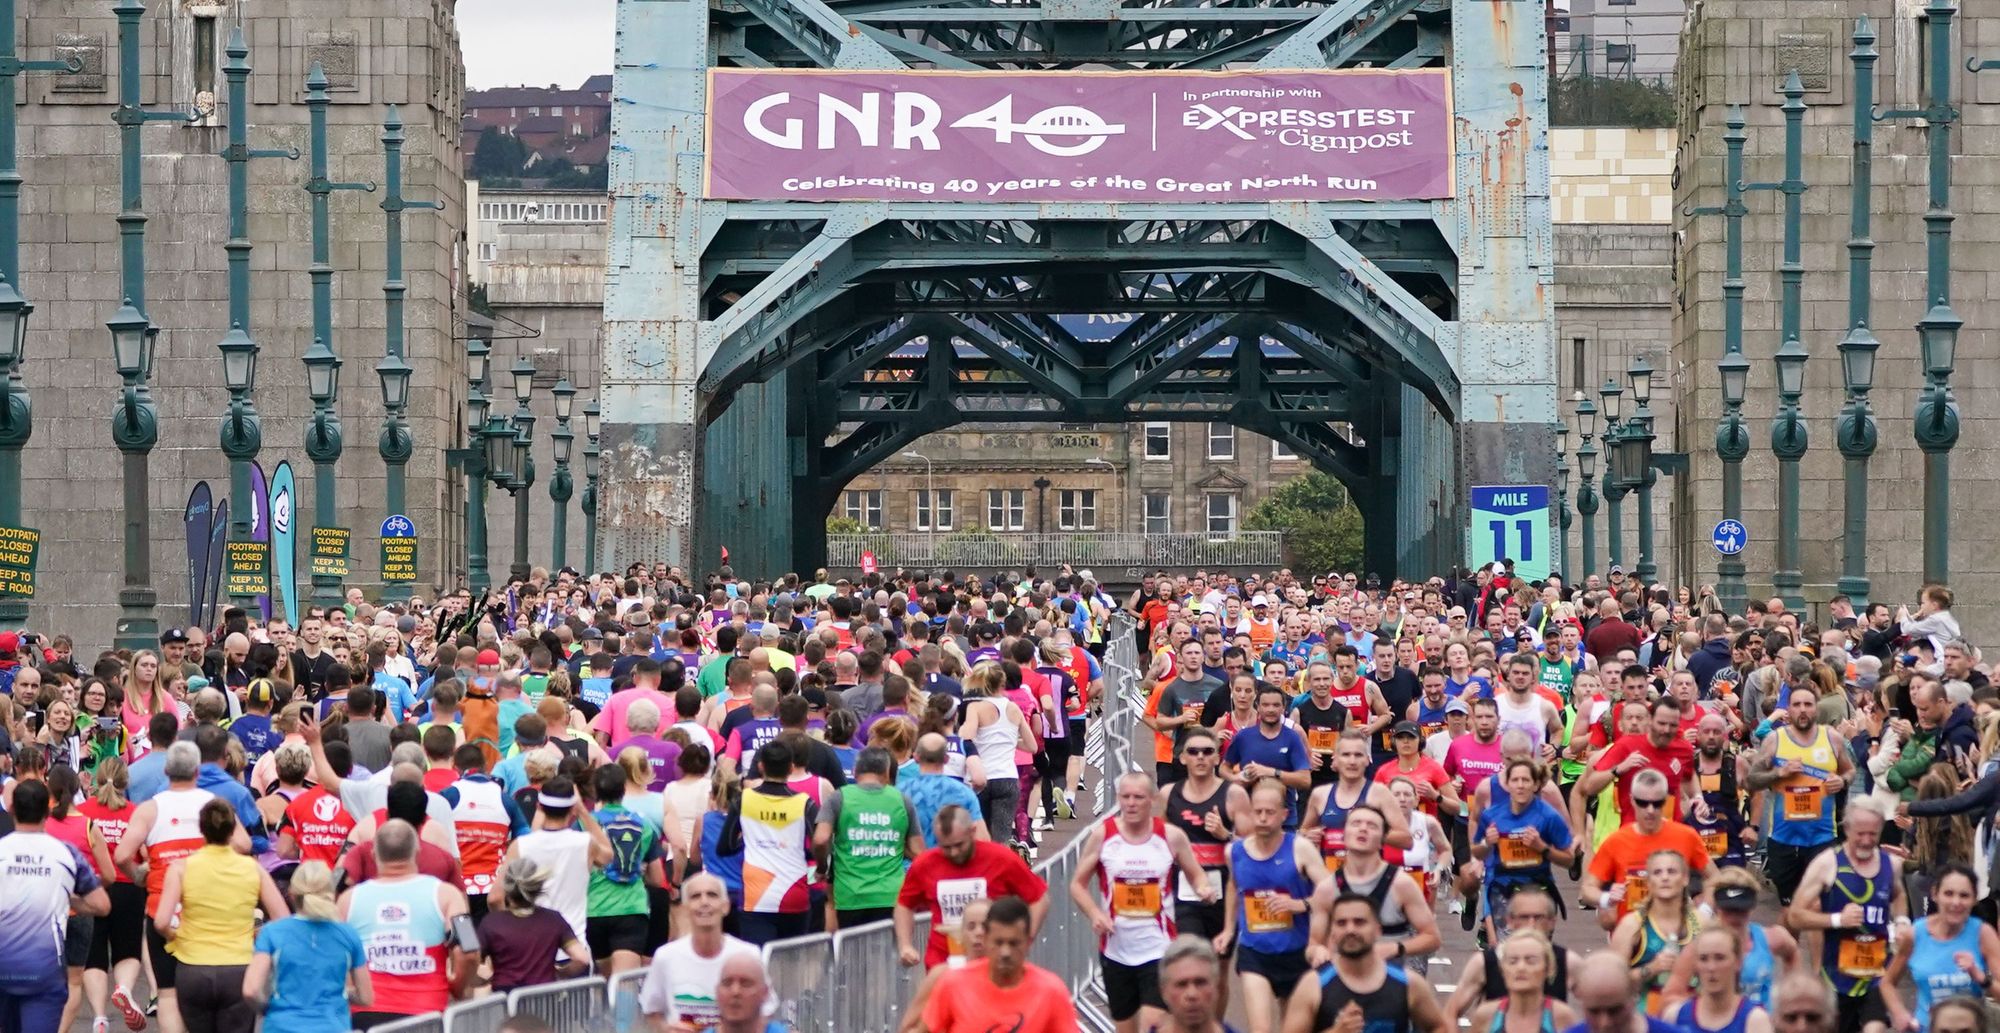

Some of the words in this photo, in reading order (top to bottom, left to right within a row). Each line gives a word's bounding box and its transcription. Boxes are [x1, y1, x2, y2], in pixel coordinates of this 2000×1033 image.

[1182, 90, 1197, 102] In
[1202, 87, 1285, 102] partnership
[1289, 87, 1322, 99] with
[1182, 103, 1416, 140] EXPRESSTEST
[1278, 128, 1414, 154] Cignpost
[782, 174, 936, 194] Celebrating
[943, 178, 979, 194] 40
[986, 177, 1062, 196] years
[1070, 175, 1098, 190] of
[1105, 174, 1147, 191] the
[1156, 177, 1233, 193] Great
[1241, 173, 1318, 190] North
[1327, 176, 1377, 191] Run
[1492, 492, 1529, 507] MILE
[0, 527, 39, 542] OOTPATH
[312, 528, 350, 538] FOOTPATH
[316, 537, 345, 546] CLOSED
[381, 537, 417, 545] FOOTPATH
[1489, 520, 1533, 562] 11
[227, 543, 267, 552] FOOTPATH
[317, 546, 343, 554] AHEAD
[231, 552, 263, 561] CLOSED
[387, 554, 411, 562] AHEAD
[314, 558, 334, 566] KEEP
[335, 559, 345, 567] TO
[0, 569, 18, 580] EEP
[20, 572, 31, 582] TO
[328, 567, 349, 576] ROAD
[396, 572, 417, 580] ROAD
[230, 575, 251, 583] KEEP
[253, 576, 264, 584] TO
[8, 582, 34, 595] ROAD
[228, 585, 244, 593] THE
[245, 585, 268, 593] ROAD
[760, 811, 788, 822] LIAM
[858, 811, 892, 826] Help
[302, 822, 328, 833] Save
[329, 823, 348, 834] the
[847, 828, 900, 842] Educate
[14, 854, 44, 865] WOLF
[6, 865, 52, 877] RUNNER
[941, 892, 979, 907] STREET
